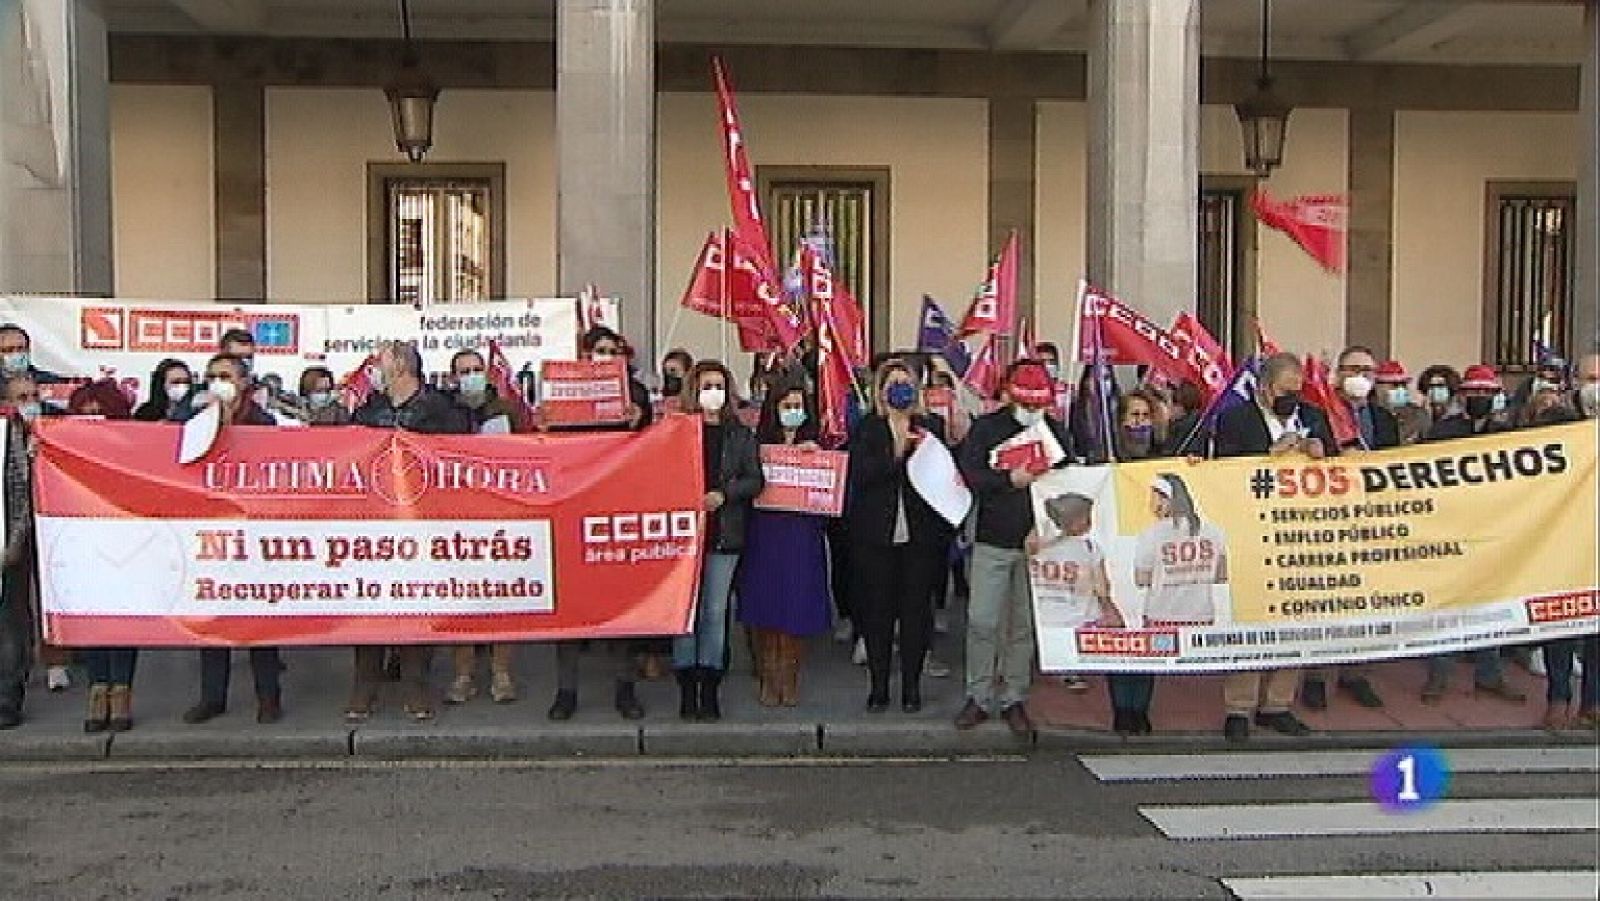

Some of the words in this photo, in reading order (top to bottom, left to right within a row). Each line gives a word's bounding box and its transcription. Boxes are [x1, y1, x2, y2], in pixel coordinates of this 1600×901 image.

[420, 314, 512, 330] federación
[518, 314, 542, 328] de
[204, 452, 367, 491] ÚLTIMA
[434, 462, 549, 493] HORA
[1250, 466, 1350, 499] #SOS
[1361, 443, 1568, 493] DERECHOS
[1270, 504, 1350, 523] SERVICIOS
[1353, 497, 1434, 518] PÚBLICOS
[583, 511, 697, 543] CCOO
[1274, 529, 1334, 545] EMPLEO
[1338, 522, 1409, 543] PÚBLICO
[195, 529, 248, 561] Ni
[259, 536, 316, 561] un
[325, 535, 419, 567] paso
[430, 529, 532, 561] atrás
[1162, 539, 1213, 566] SOS
[1276, 551, 1347, 568] CARRERA
[1351, 541, 1464, 564] PROFESIONAL
[195, 577, 349, 604] Recuperar
[356, 577, 382, 598] lo
[390, 577, 544, 599] arrebatado
[1278, 573, 1361, 591] IGUALDAD
[1280, 596, 1366, 616] CONVENIO
[1370, 590, 1424, 608] ÚNICO
